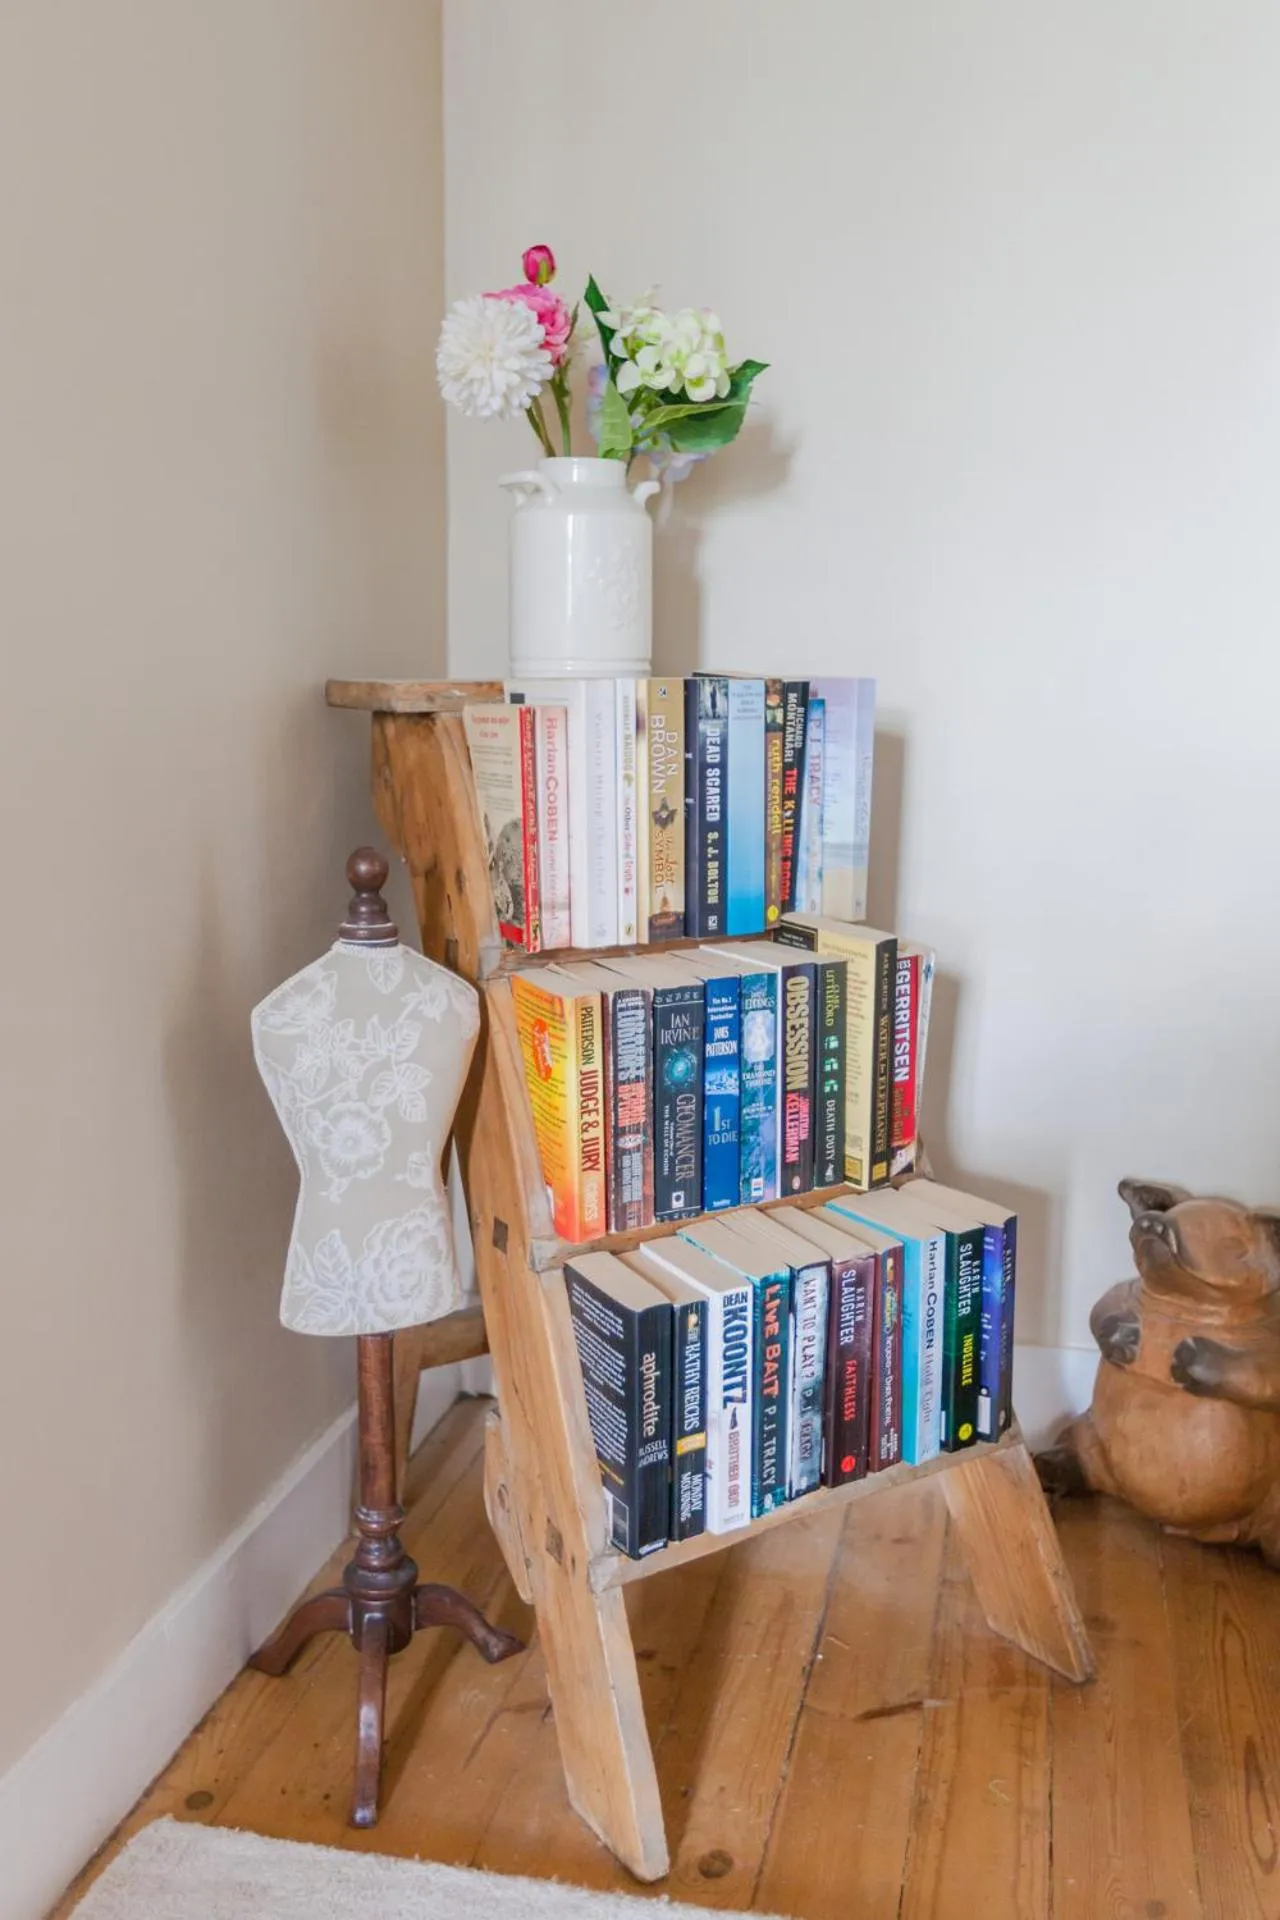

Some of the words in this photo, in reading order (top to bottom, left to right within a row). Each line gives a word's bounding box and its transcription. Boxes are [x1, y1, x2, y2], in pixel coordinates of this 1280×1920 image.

[546, 717, 559, 774] Harlan
[705, 727, 721, 764] DEAD
[784, 692, 798, 763] MONTANARI
[795, 707, 806, 748] RICHARD
[650, 714, 668, 794] BROWN
[666, 731, 679, 777] DAN
[771, 739, 782, 773] ruth
[705, 767, 721, 822] SCARED
[784, 768, 799, 796] THE
[809, 752, 822, 808] TRACY
[546, 775, 560, 841] COBEN
[770, 779, 782, 834] rendell
[706, 831, 720, 843] S.
[706, 846, 720, 859] J.
[653, 828, 667, 893] SYMBOL
[665, 853, 678, 885] Lost
[706, 860, 719, 905] BOLTON
[671, 1012, 690, 1029] IAN
[825, 969, 836, 1027] LITTLEFORD
[580, 1006, 596, 1065] PATTERSON
[661, 1027, 700, 1046] IRVINE
[705, 1040, 738, 1058] PATTERSON
[785, 975, 809, 1091] OBSESSION
[878, 1014, 889, 1061] WATER
[894, 970, 911, 1082] GERRITSEN
[580, 1069, 600, 1123] JUDGE
[826, 1099, 836, 1132] DEATH
[875, 1076, 888, 1154] ELEPHANTS
[894, 1087, 905, 1119] Silent
[581, 1123, 598, 1134] &
[675, 1093, 697, 1183] GEOMANCER
[708, 1133, 720, 1145] TO
[721, 1130, 738, 1144] DIE
[785, 1092, 801, 1163] KELLERMAN
[824, 1135, 835, 1161] DUTY
[581, 1136, 601, 1173] JURY
[927, 1239, 939, 1290] Harlan
[957, 1242, 973, 1317] SLAUGHTER
[970, 1259, 980, 1294] KARIN
[722, 1291, 748, 1308] DEAN
[764, 1283, 782, 1338] LIVE
[801, 1278, 816, 1311] WANT
[839, 1269, 857, 1346] SLAUGHTER
[856, 1287, 865, 1322] KARIN
[801, 1316, 816, 1330] TO
[925, 1292, 938, 1349] COBEN
[684, 1342, 701, 1386] KATHY
[722, 1305, 748, 1411] KOONTZ
[763, 1343, 782, 1399] BAIT
[800, 1336, 816, 1379] PLAY?
[923, 1352, 934, 1386] Hold
[961, 1333, 974, 1387] INDELIBLE
[641, 1351, 659, 1438] aphrodite
[684, 1387, 701, 1431] REICHS
[843, 1359, 857, 1422] FAITHLESS
[728, 1430, 741, 1483] BROTHER
[799, 1420, 813, 1461] TRACY
[690, 1473, 703, 1511] MONDAY
